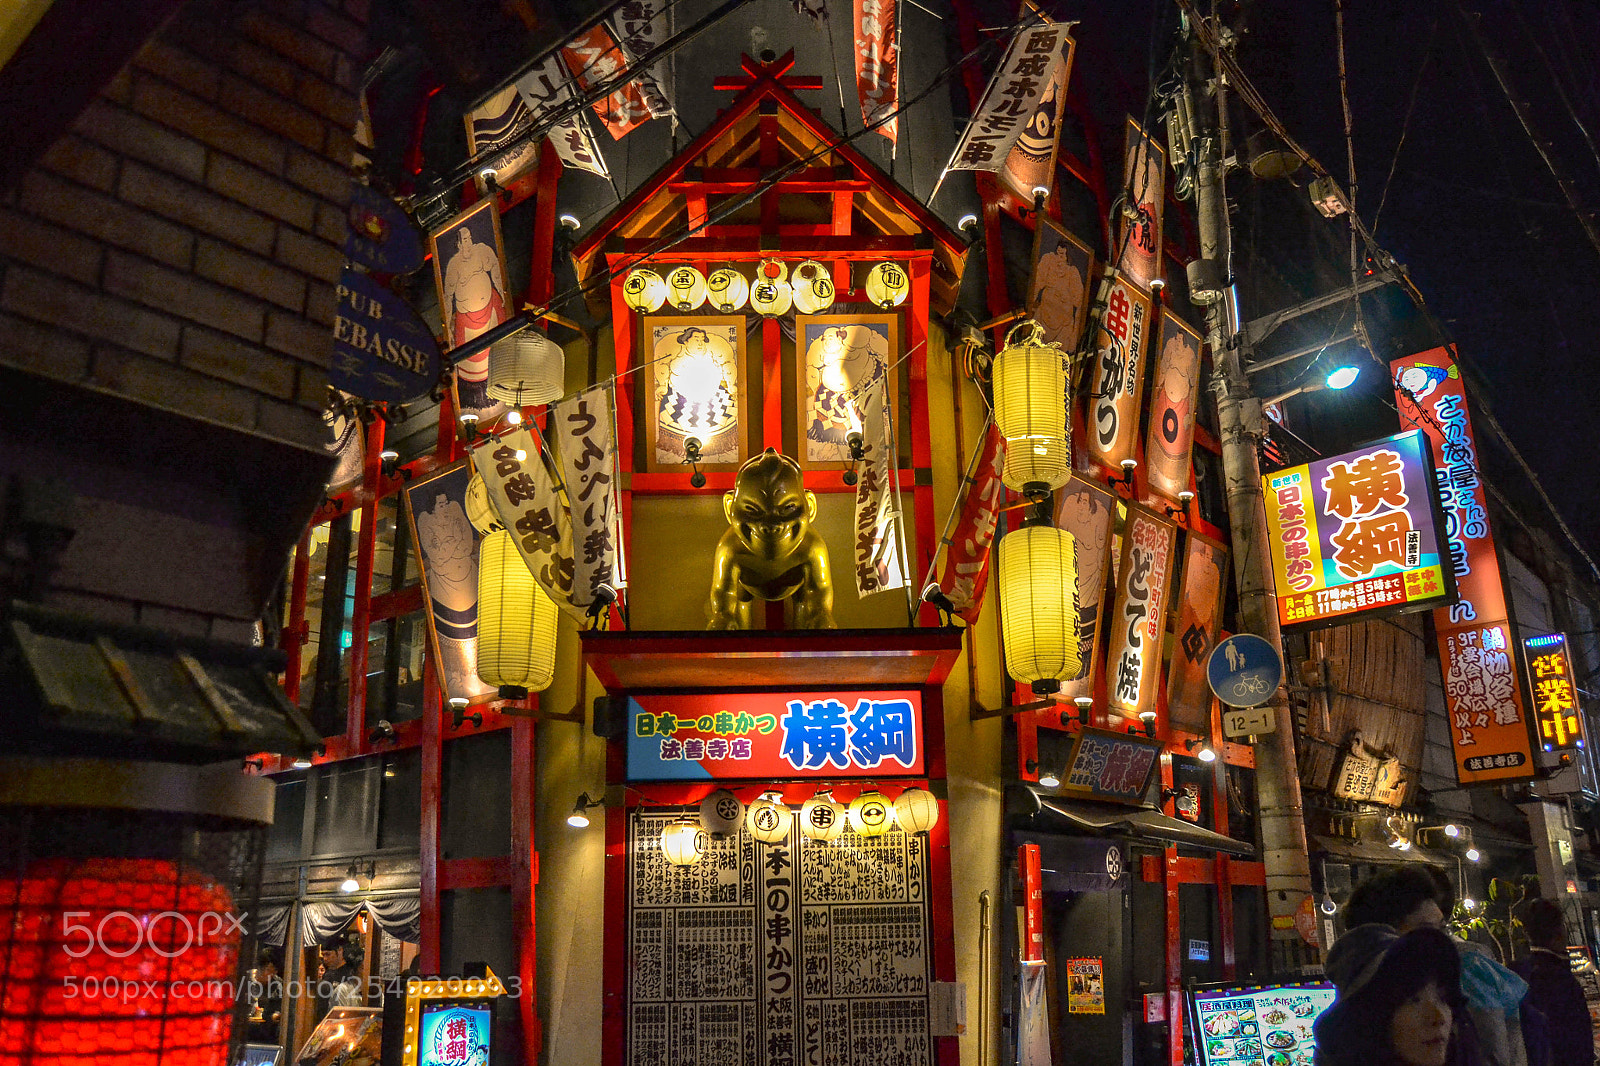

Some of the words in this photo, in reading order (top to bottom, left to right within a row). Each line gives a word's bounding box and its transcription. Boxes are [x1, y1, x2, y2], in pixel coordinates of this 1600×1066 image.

[960, 29, 1059, 165] 西成ホルモン串
[336, 284, 383, 320] PUB
[1095, 286, 1133, 453] 串かつ
[1128, 302, 1144, 397] 新世界名物
[1272, 473, 1301, 488] 新世界
[1434, 394, 1488, 538] さかな屋さんの
[1132, 518, 1157, 550] 名物
[1276, 486, 1316, 592] 日本一の串かつ
[1321, 450, 1414, 581] 横綱
[1407, 531, 1419, 565] 法善寺
[1147, 528, 1169, 641] 大阪下町の味
[1406, 569, 1436, 584] 年中
[1408, 581, 1438, 597] 無休
[1115, 547, 1153, 706] どて焼
[1287, 604, 1316, 620] 土日祝
[1481, 626, 1522, 726] 鍋物各種
[1532, 653, 1579, 746] 営業中
[636, 711, 778, 737] 日本一の串かつ
[780, 699, 917, 770] 横綱
[1231, 714, 1269, 731] 12-1
[1447, 681, 1476, 746] 50人以上
[660, 738, 752, 760] 法善寺店
[1080, 740, 1109, 757] 日本一の
[812, 807, 832, 826] 串
[743, 842, 753, 903] 酒の肴
[830, 849, 838, 901] ししとう
[850, 849, 857, 901] なす
[909, 838, 921, 900] 串かつ
[804, 910, 828, 930] 串かつ
[806, 956, 829, 975] 盛り
[806, 976, 829, 995] 合わせ
[861, 940, 868, 993] もち
[888, 940, 896, 993] サーモン
[895, 940, 903, 993] エビ
[909, 940, 917, 993] タコ
[916, 940, 924, 993] イカ
[767, 997, 793, 1013] 大阪
[767, 1013, 793, 1030] 法善寺
[447, 1017, 467, 1060] 横綱
